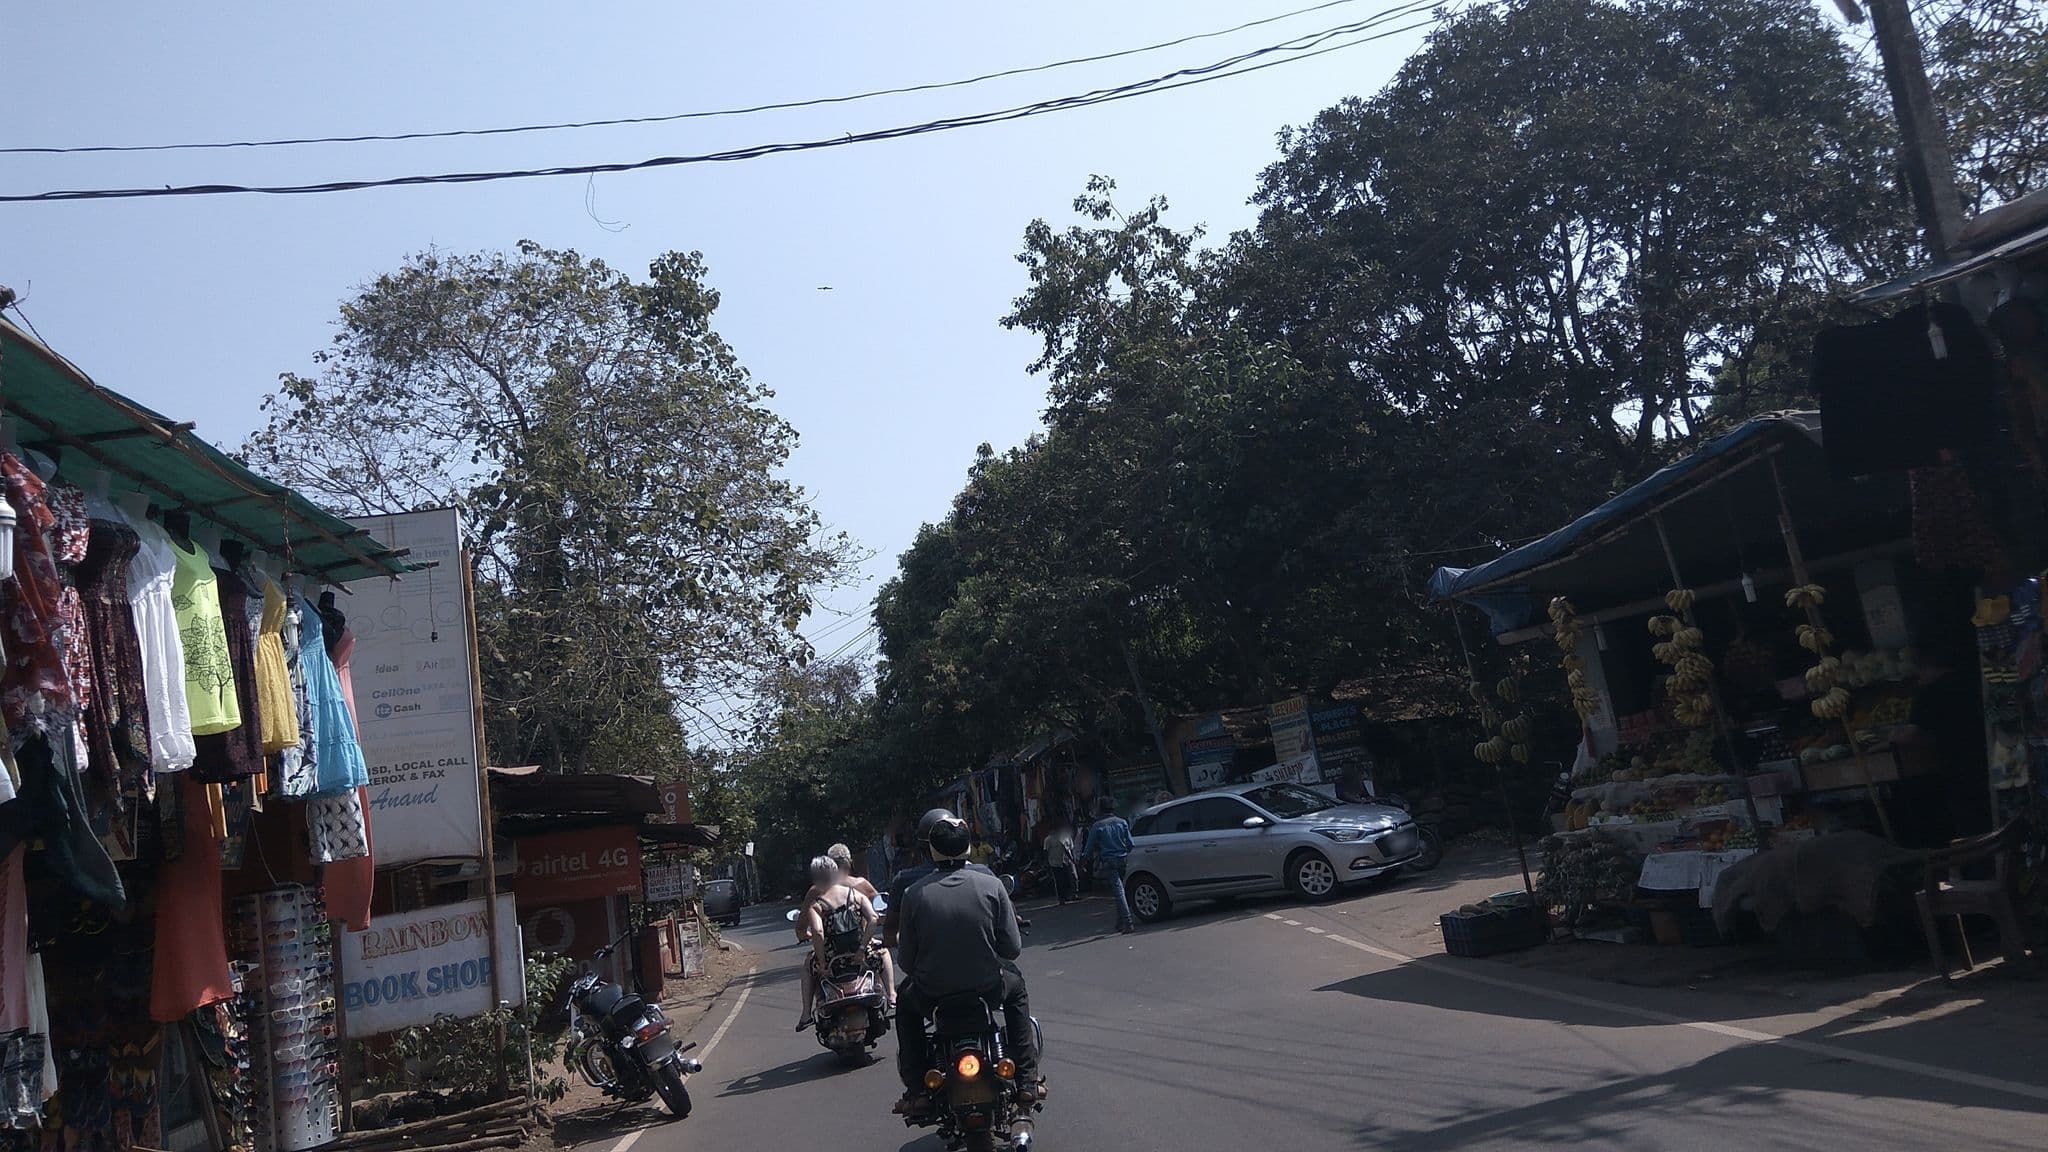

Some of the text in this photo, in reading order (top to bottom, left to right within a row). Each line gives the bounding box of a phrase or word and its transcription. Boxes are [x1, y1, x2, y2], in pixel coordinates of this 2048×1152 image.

[371, 687, 421, 700] CellOne
[394, 703, 421, 713] Cash
[394, 759, 435, 773] LOCAL
[437, 756, 469, 768] CALL
[409, 771, 420, 781] &
[422, 768, 446, 780] FAX
[369, 783, 440, 811] Anand
[529, 849, 590, 876] airtel
[598, 847, 629, 868] 4G
[359, 911, 488, 960] RAINBOW
[344, 957, 492, 1011] BOOK SHOP
